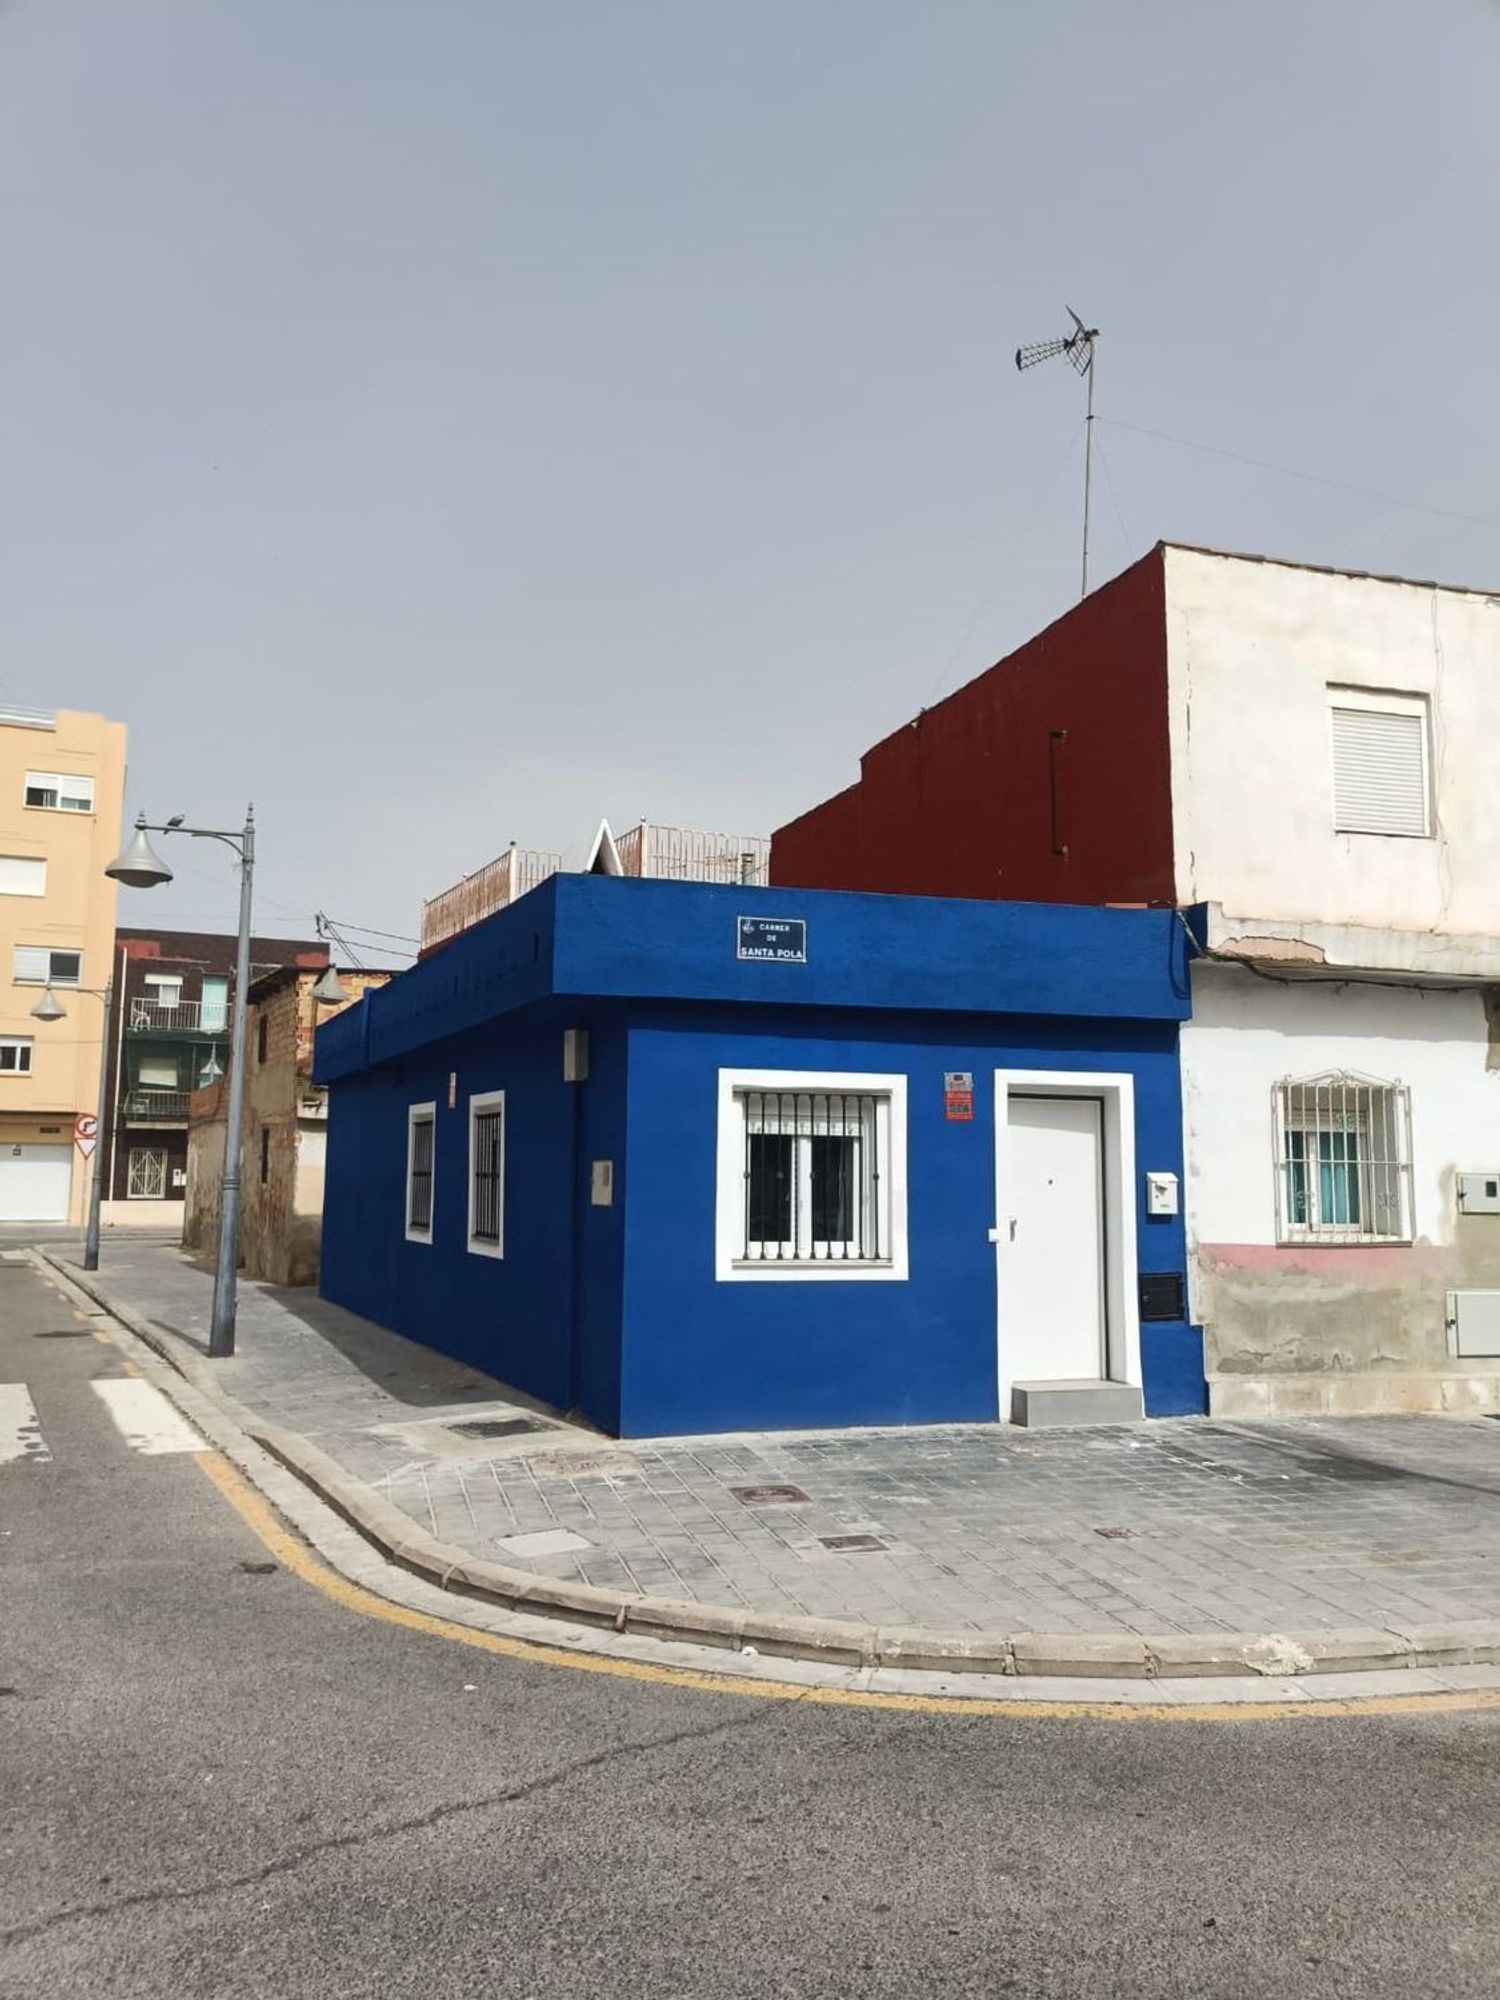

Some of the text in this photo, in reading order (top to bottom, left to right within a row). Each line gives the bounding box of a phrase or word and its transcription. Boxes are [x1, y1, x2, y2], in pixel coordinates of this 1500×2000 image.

[759, 923, 790, 932] CARRER
[766, 934, 777, 942] DE
[741, 947, 803, 958] SANTA POLA
